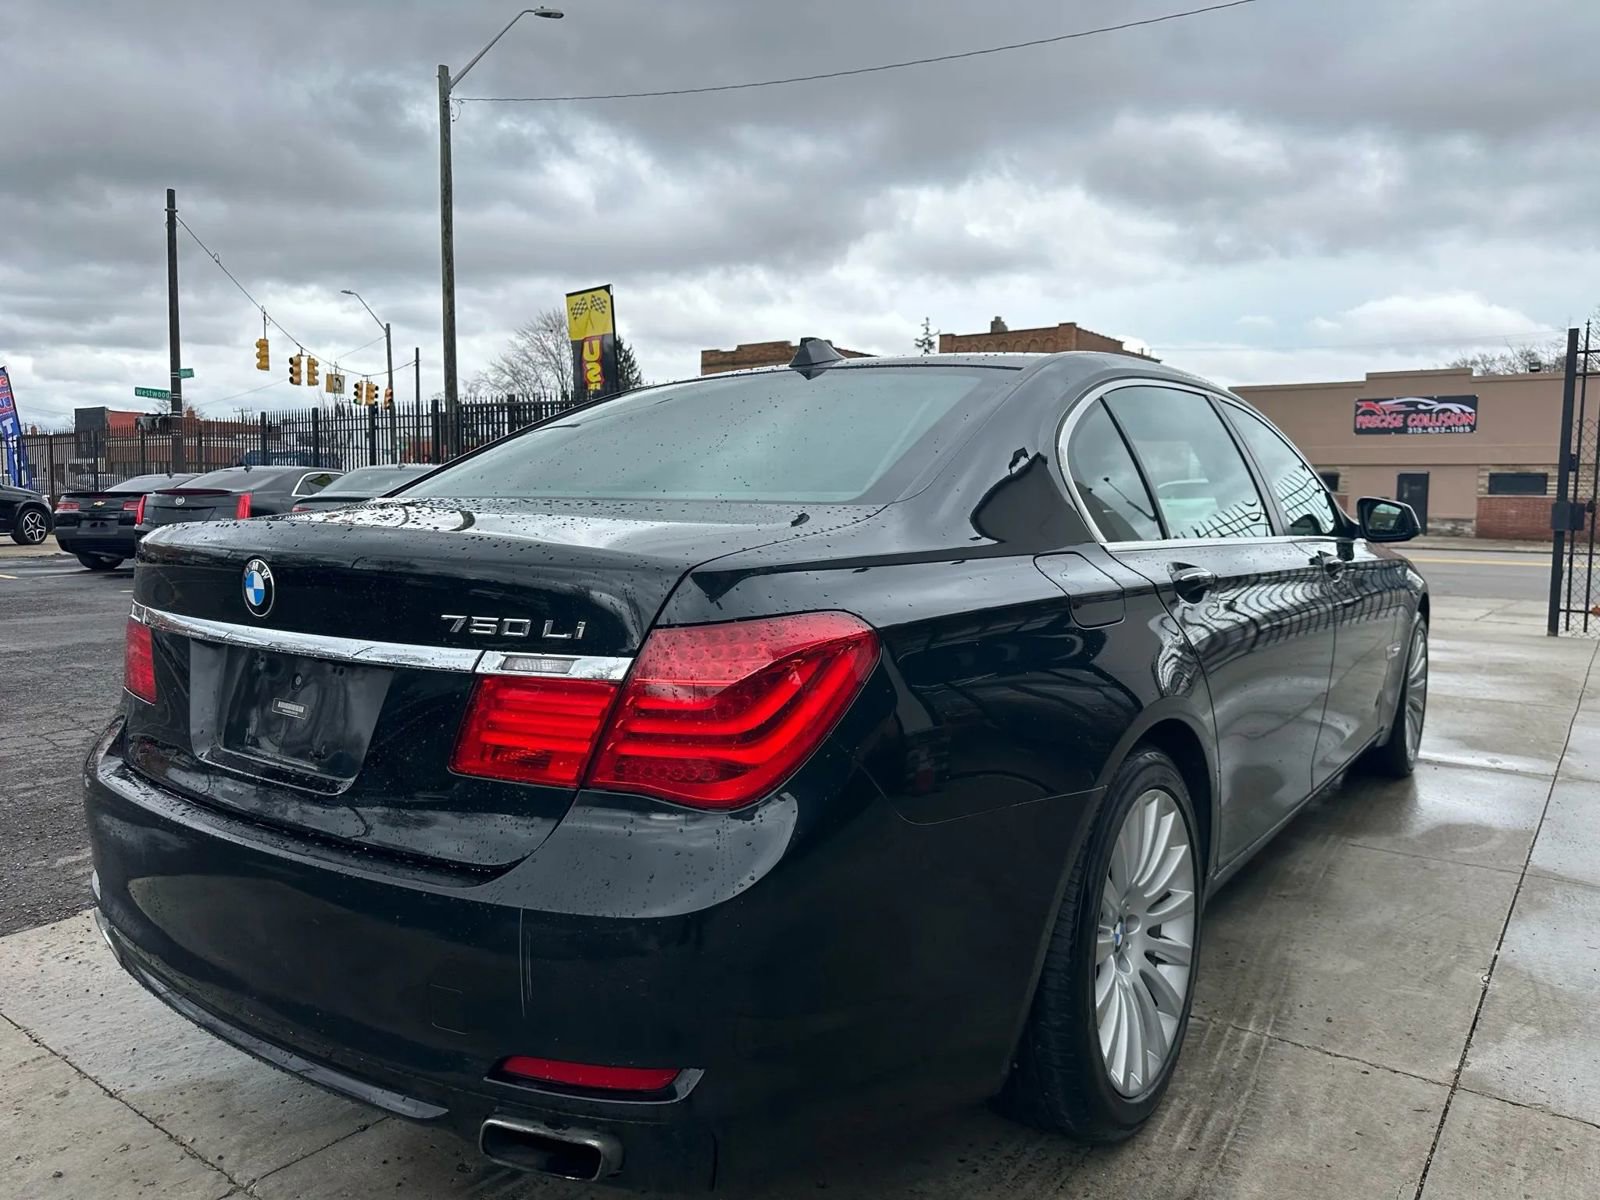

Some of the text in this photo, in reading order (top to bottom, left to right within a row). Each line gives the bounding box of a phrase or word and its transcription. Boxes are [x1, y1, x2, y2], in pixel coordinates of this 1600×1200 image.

[136, 388, 170, 399] Westwood
[1356, 411, 1475, 429] PRECISE COLLISION
[440, 614, 587, 640] 750 Li
